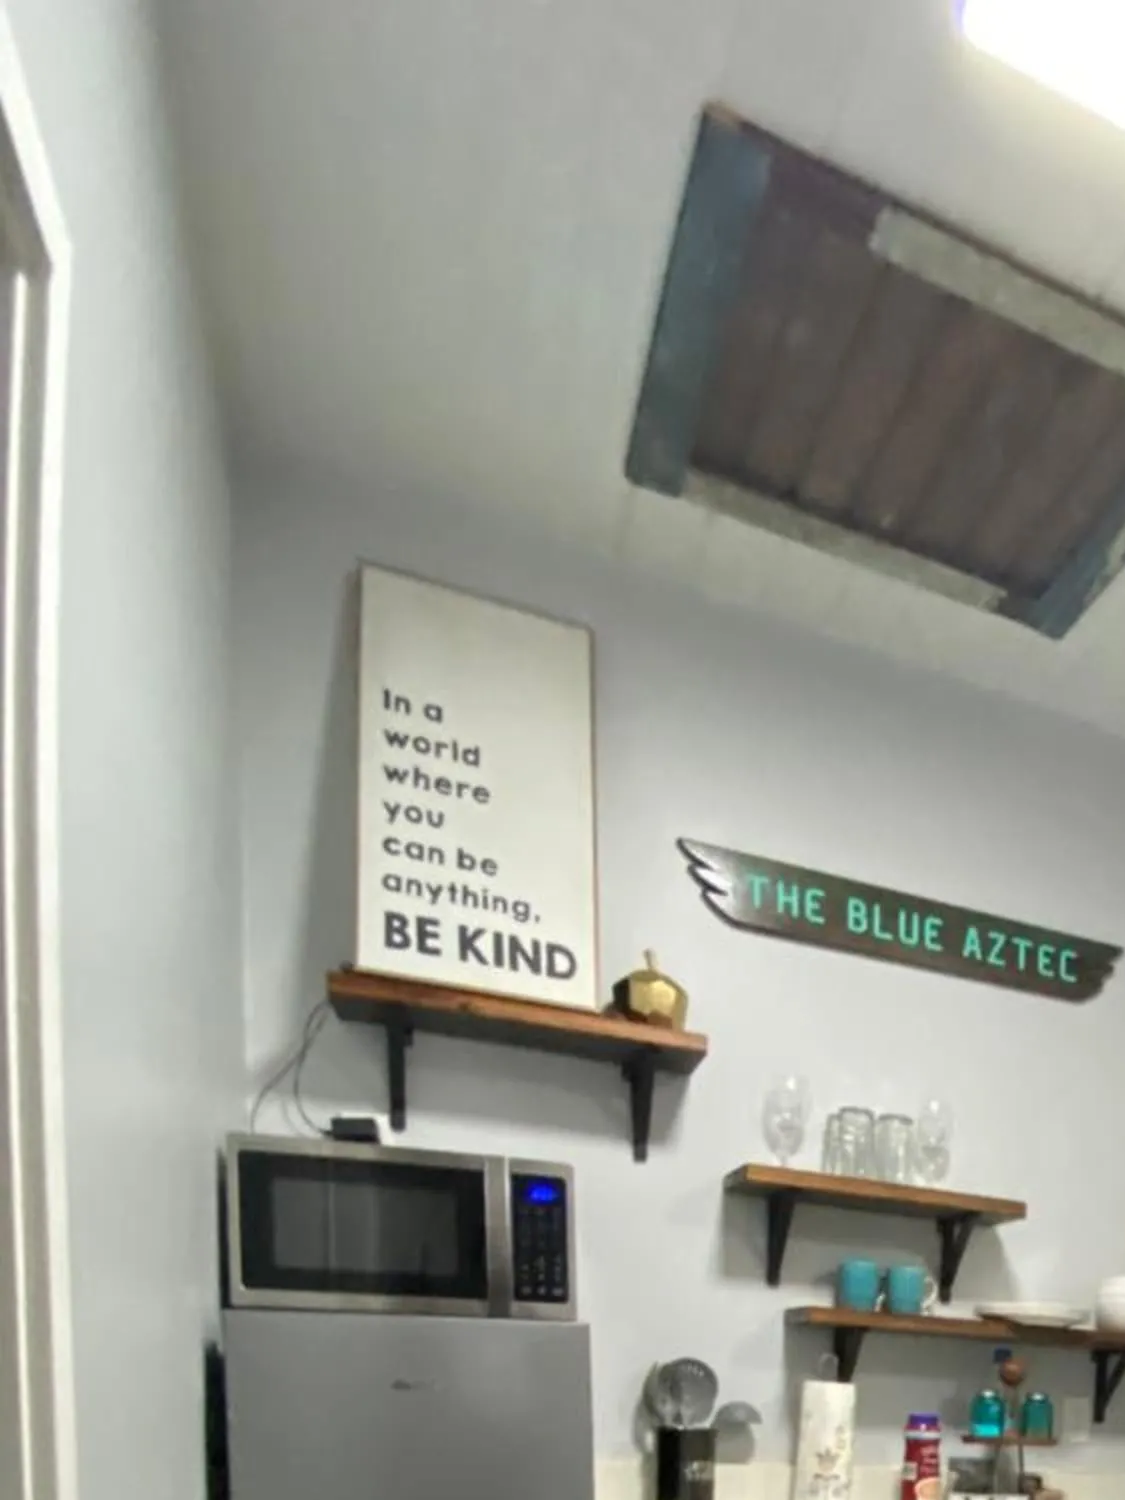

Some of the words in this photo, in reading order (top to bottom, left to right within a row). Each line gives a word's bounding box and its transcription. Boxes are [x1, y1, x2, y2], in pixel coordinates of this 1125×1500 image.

[382, 688, 412, 716] In
[423, 701, 443, 723] a
[384, 729, 480, 767] world
[384, 763, 490, 804] where
[383, 799, 444, 829] you
[382, 836, 444, 866] can
[457, 847, 498, 877] be
[382, 872, 541, 924] anything,
[383, 911, 442, 957] BE
[458, 925, 577, 980] KIND
[747, 875, 825, 924] THE
[847, 897, 943, 952] BLUE
[962, 926, 1078, 983] AZTEC
